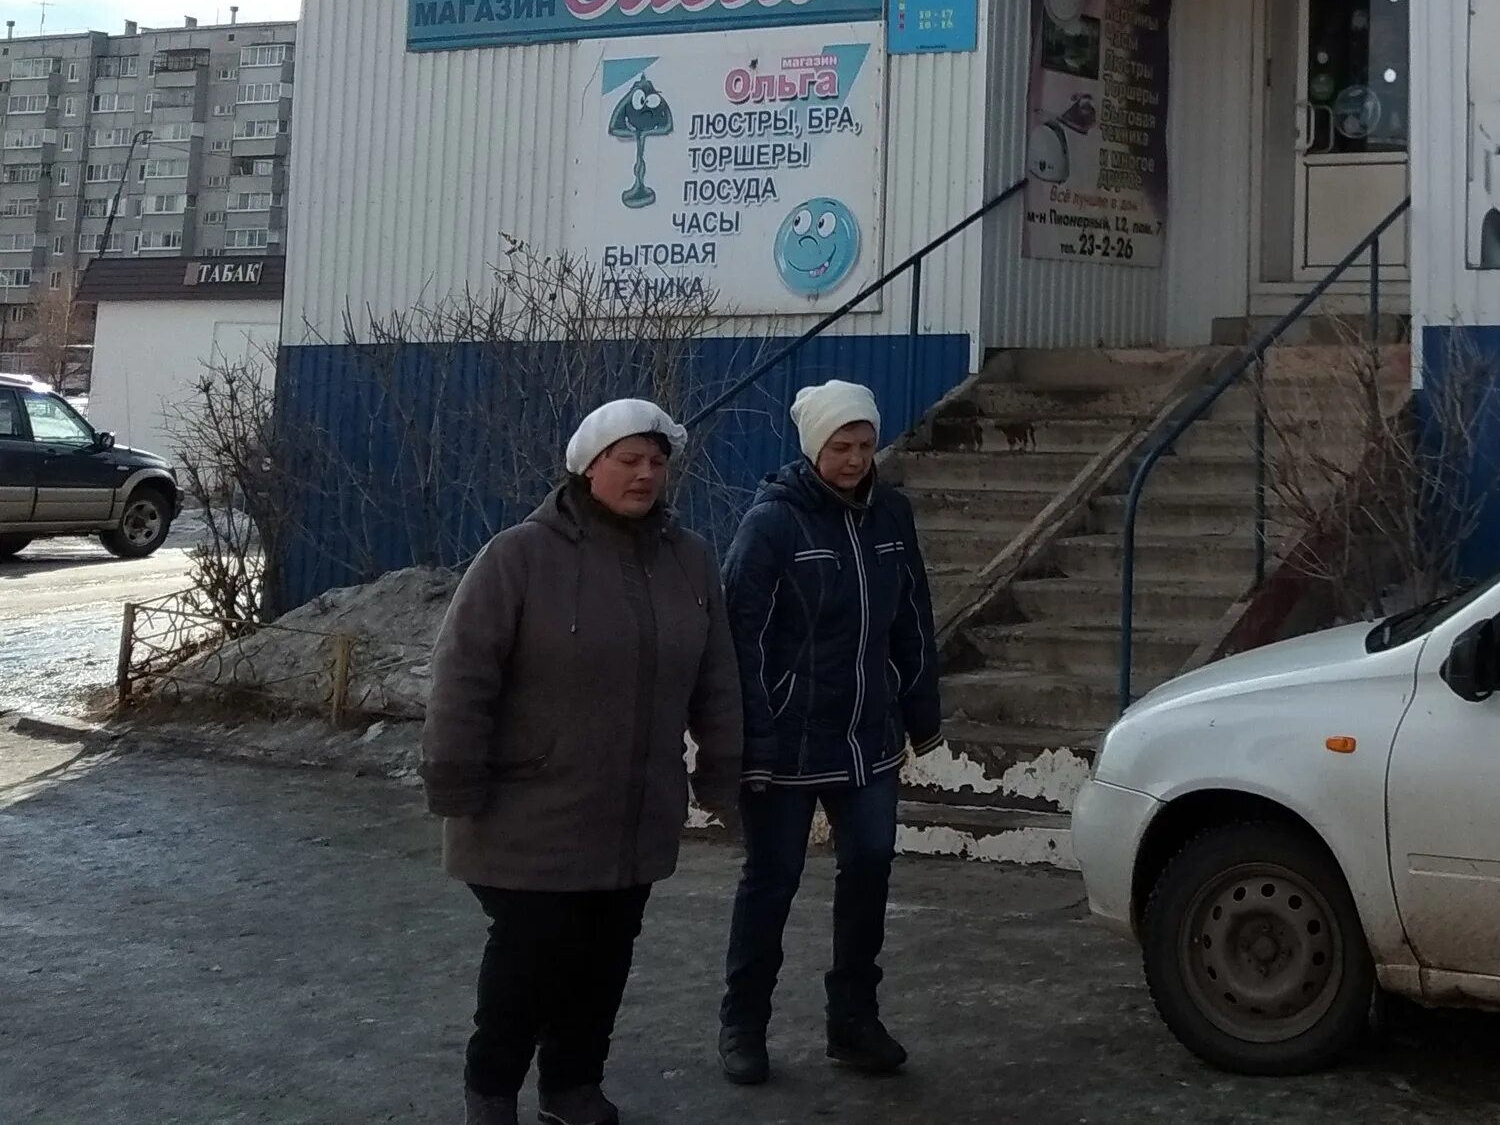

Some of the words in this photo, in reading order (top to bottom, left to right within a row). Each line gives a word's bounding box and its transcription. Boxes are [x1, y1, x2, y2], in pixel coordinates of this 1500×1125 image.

[781, 56, 838, 69] магазин
[725, 68, 839, 103] Ольга
[688, 108, 802, 139] ЛЮСТРЫ,
[808, 106, 862, 135] БРА,
[688, 142, 810, 170] ТОРШЕРЫ
[683, 177, 778, 203] ПОСУДА
[672, 211, 740, 234] ЧАСЫ
[604, 242, 717, 267] БЫТОВАЯ
[1079, 233, 1134, 260] 23-2-26
[199, 263, 260, 283] ТАБАК
[603, 276, 704, 300] ТЕХНИКА
